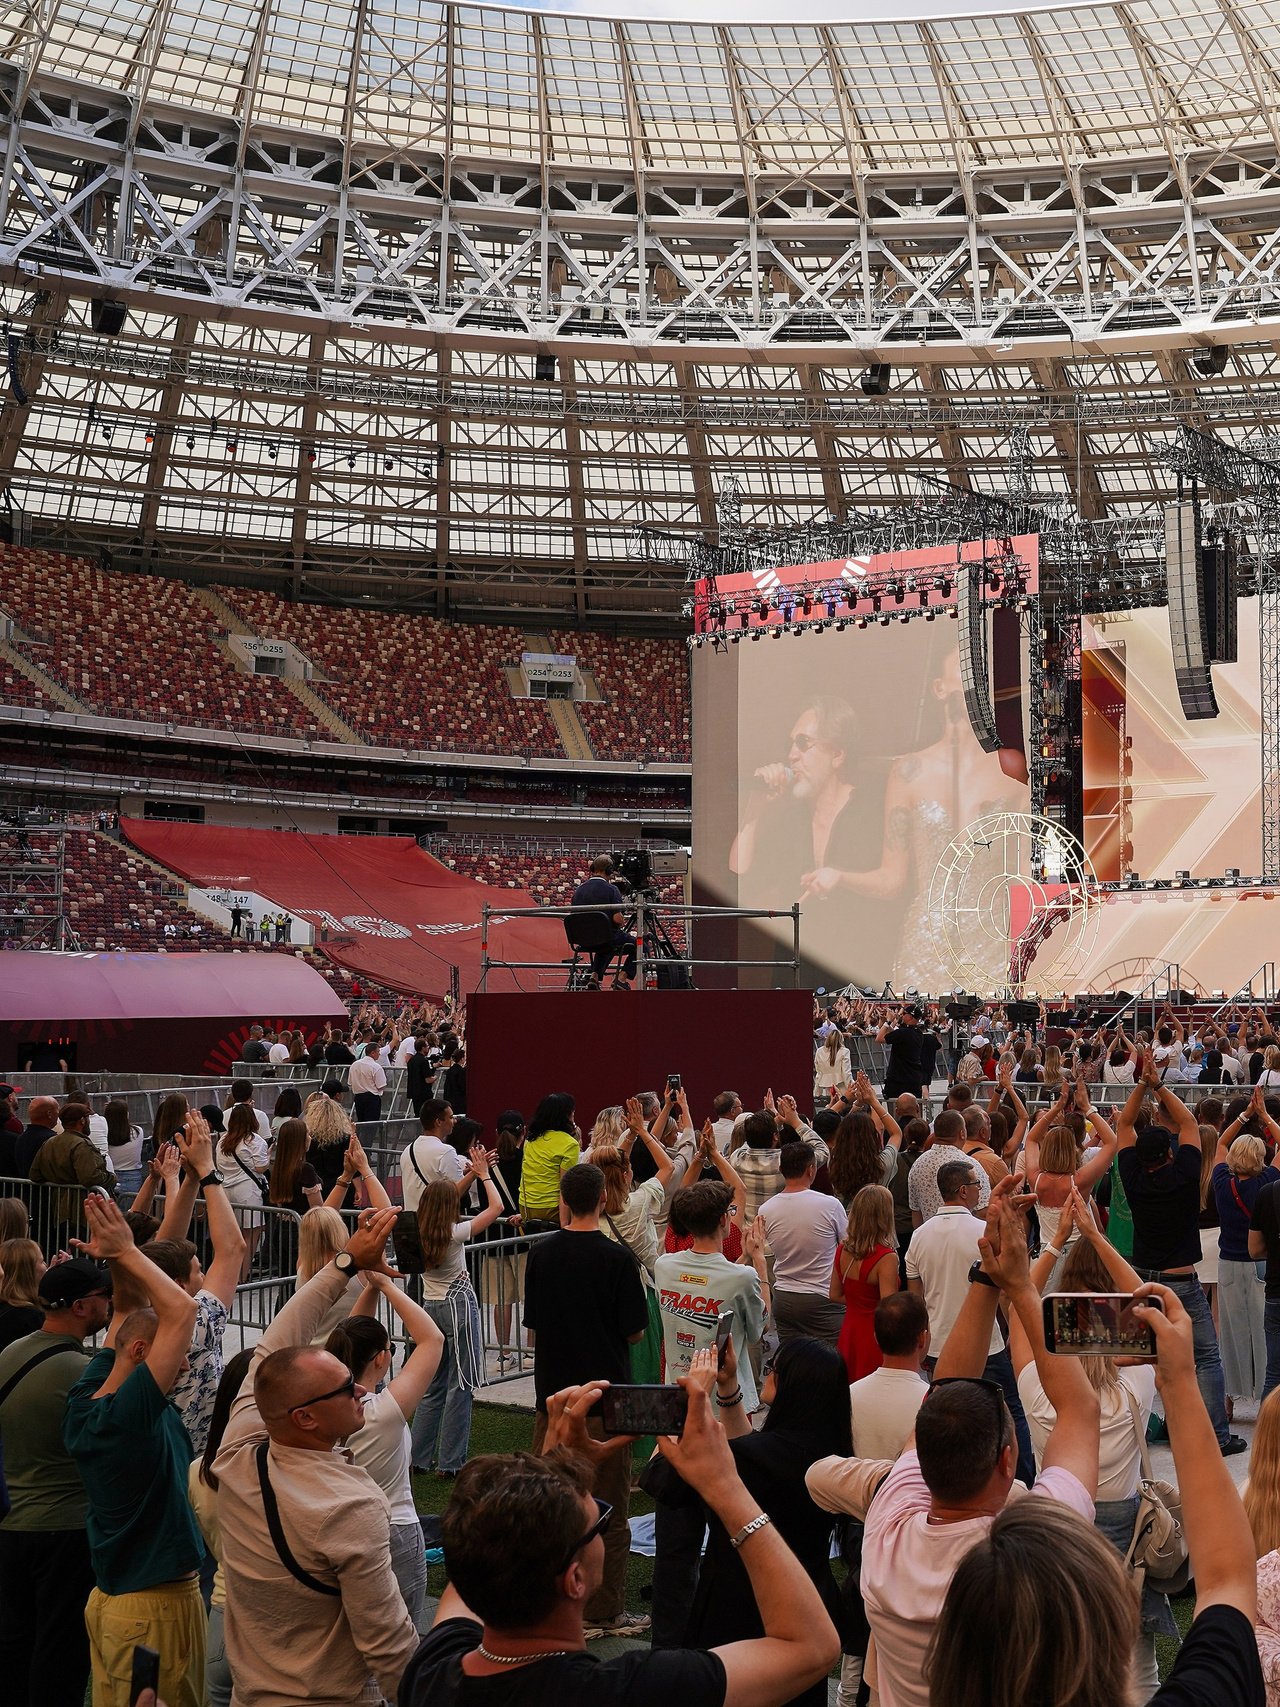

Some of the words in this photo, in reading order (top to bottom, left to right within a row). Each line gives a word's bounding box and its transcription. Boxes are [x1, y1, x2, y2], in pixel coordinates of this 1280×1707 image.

[234, 896, 249, 904] 147
[416, 922, 463, 930] ДЕНЬ
[426, 915, 520, 935] СТРОИЕЛ
[660, 1289, 724, 1315] TRACK
